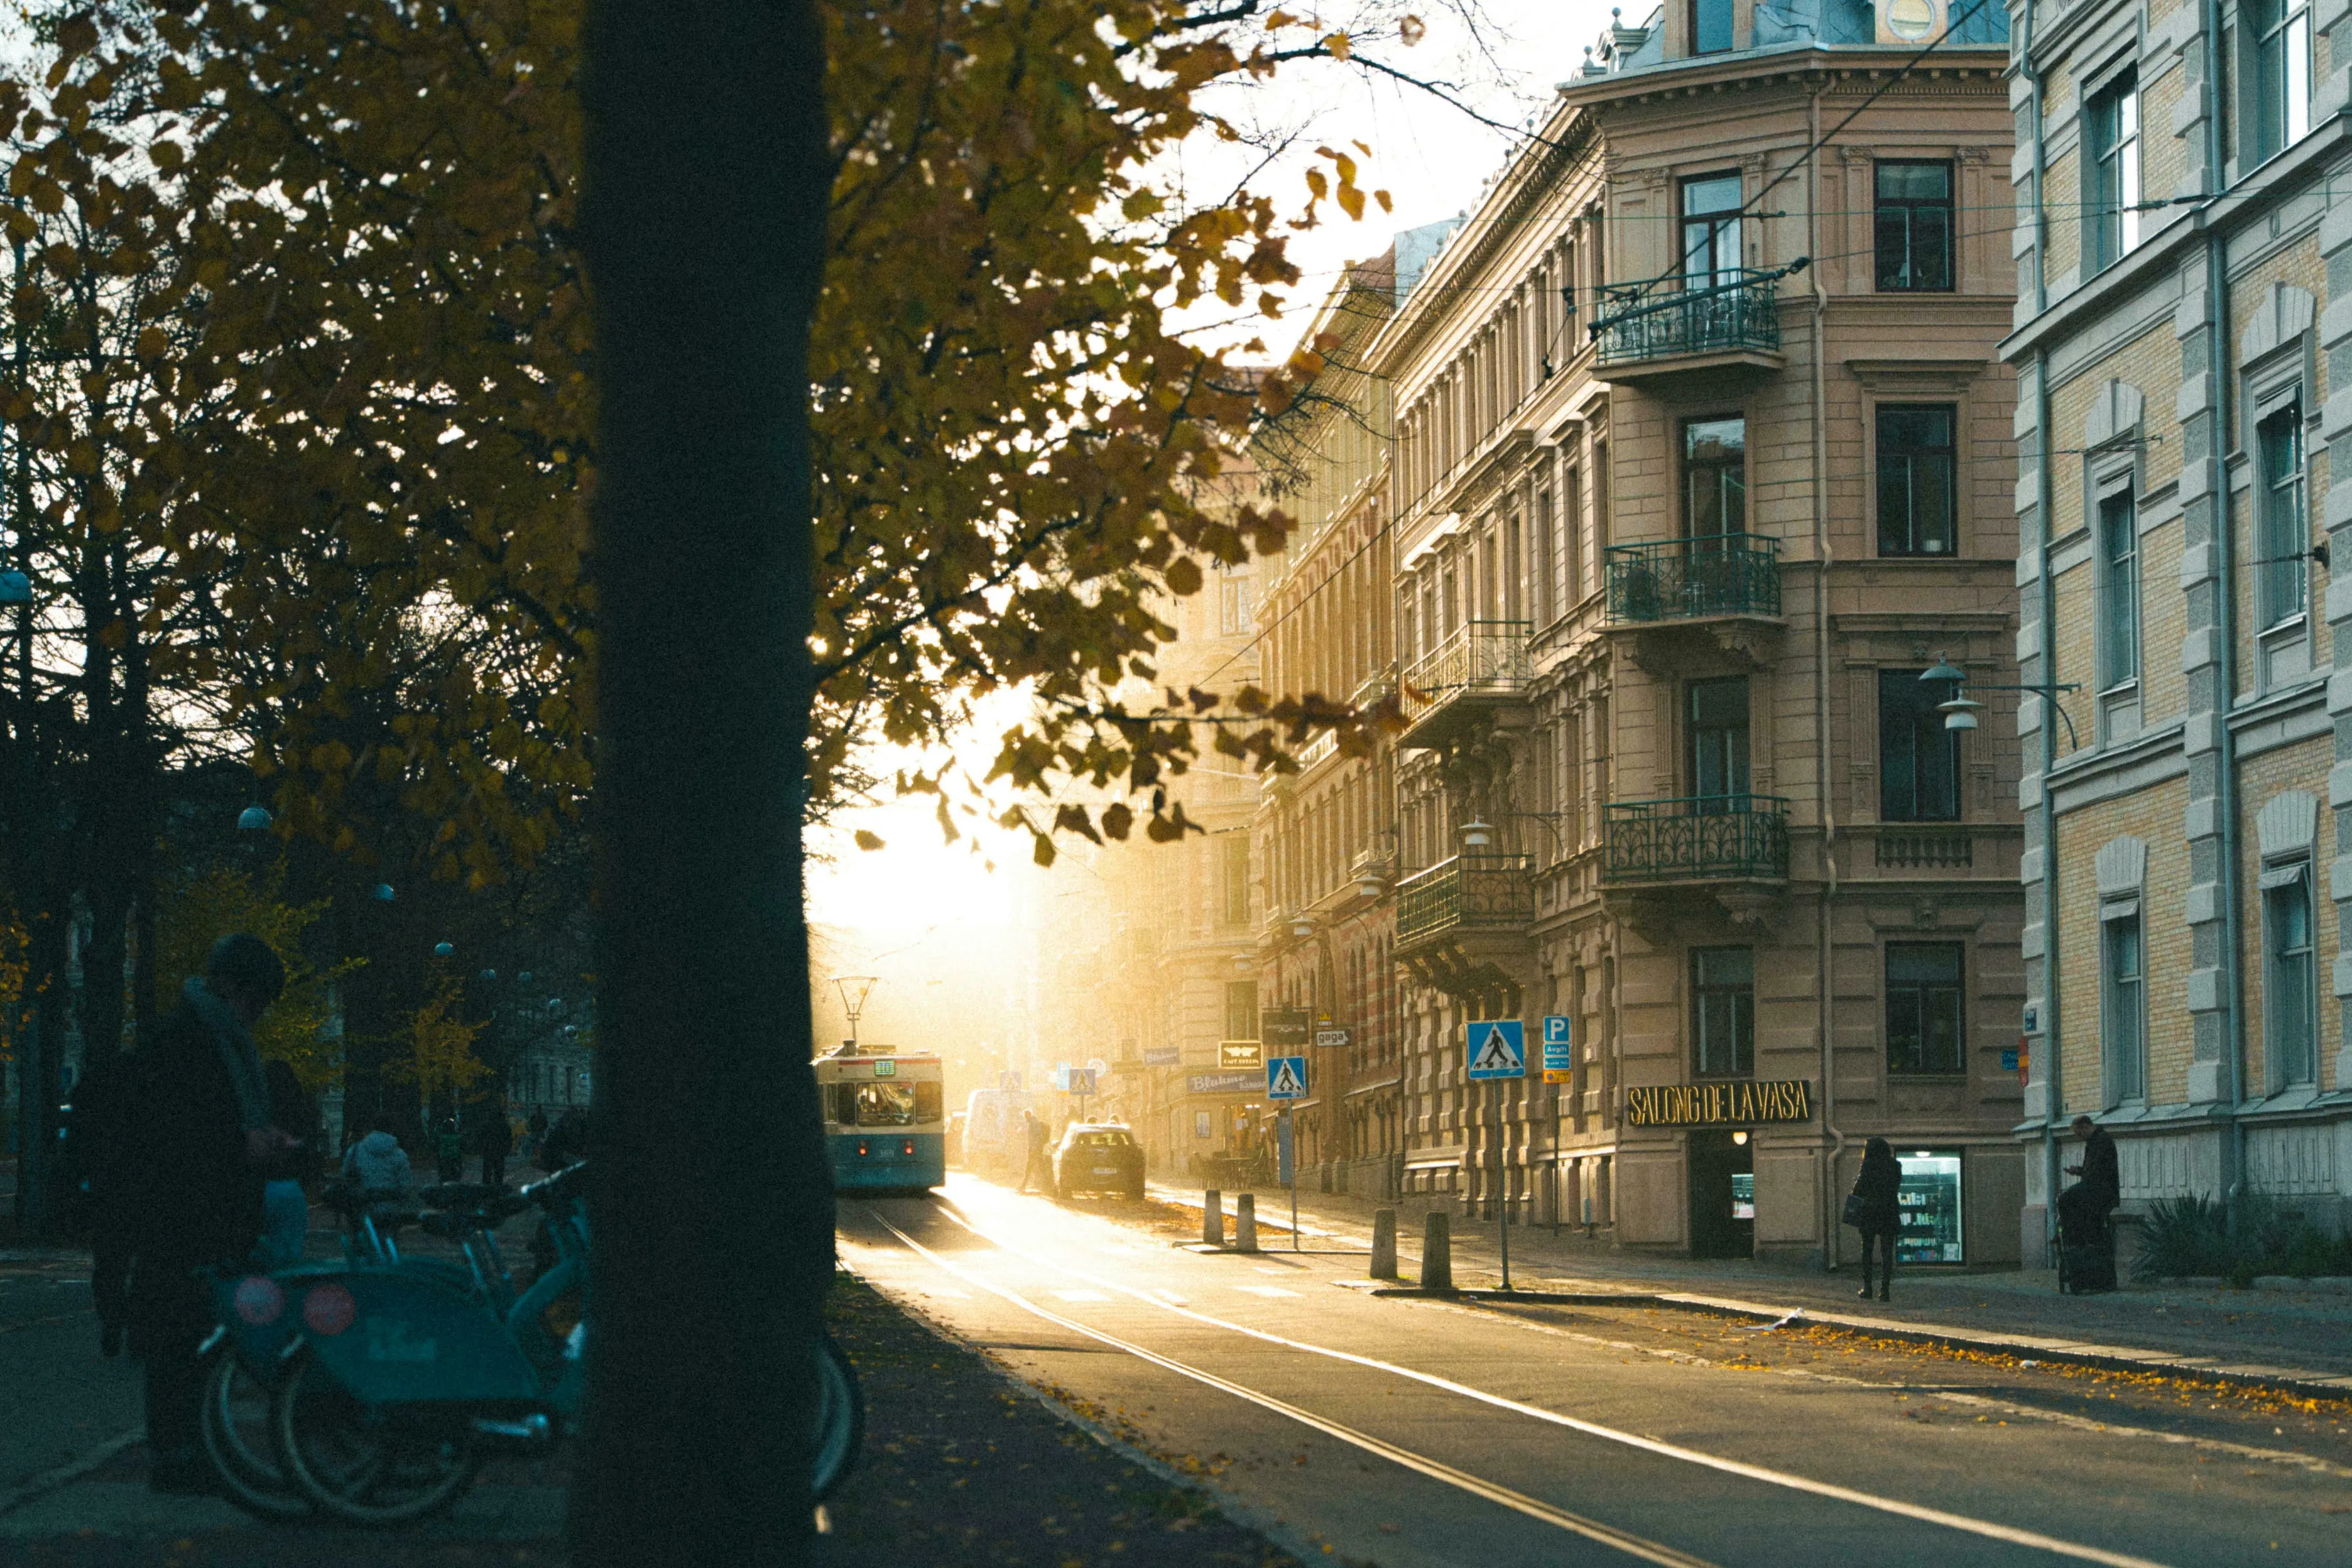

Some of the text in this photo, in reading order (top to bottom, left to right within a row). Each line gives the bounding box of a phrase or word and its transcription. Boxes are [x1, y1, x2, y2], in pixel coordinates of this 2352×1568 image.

[1319, 1033, 1343, 1043] gaga
[1551, 1019, 1565, 1039] P
[1630, 1081, 1808, 1125] SALONG DE LA VASA
